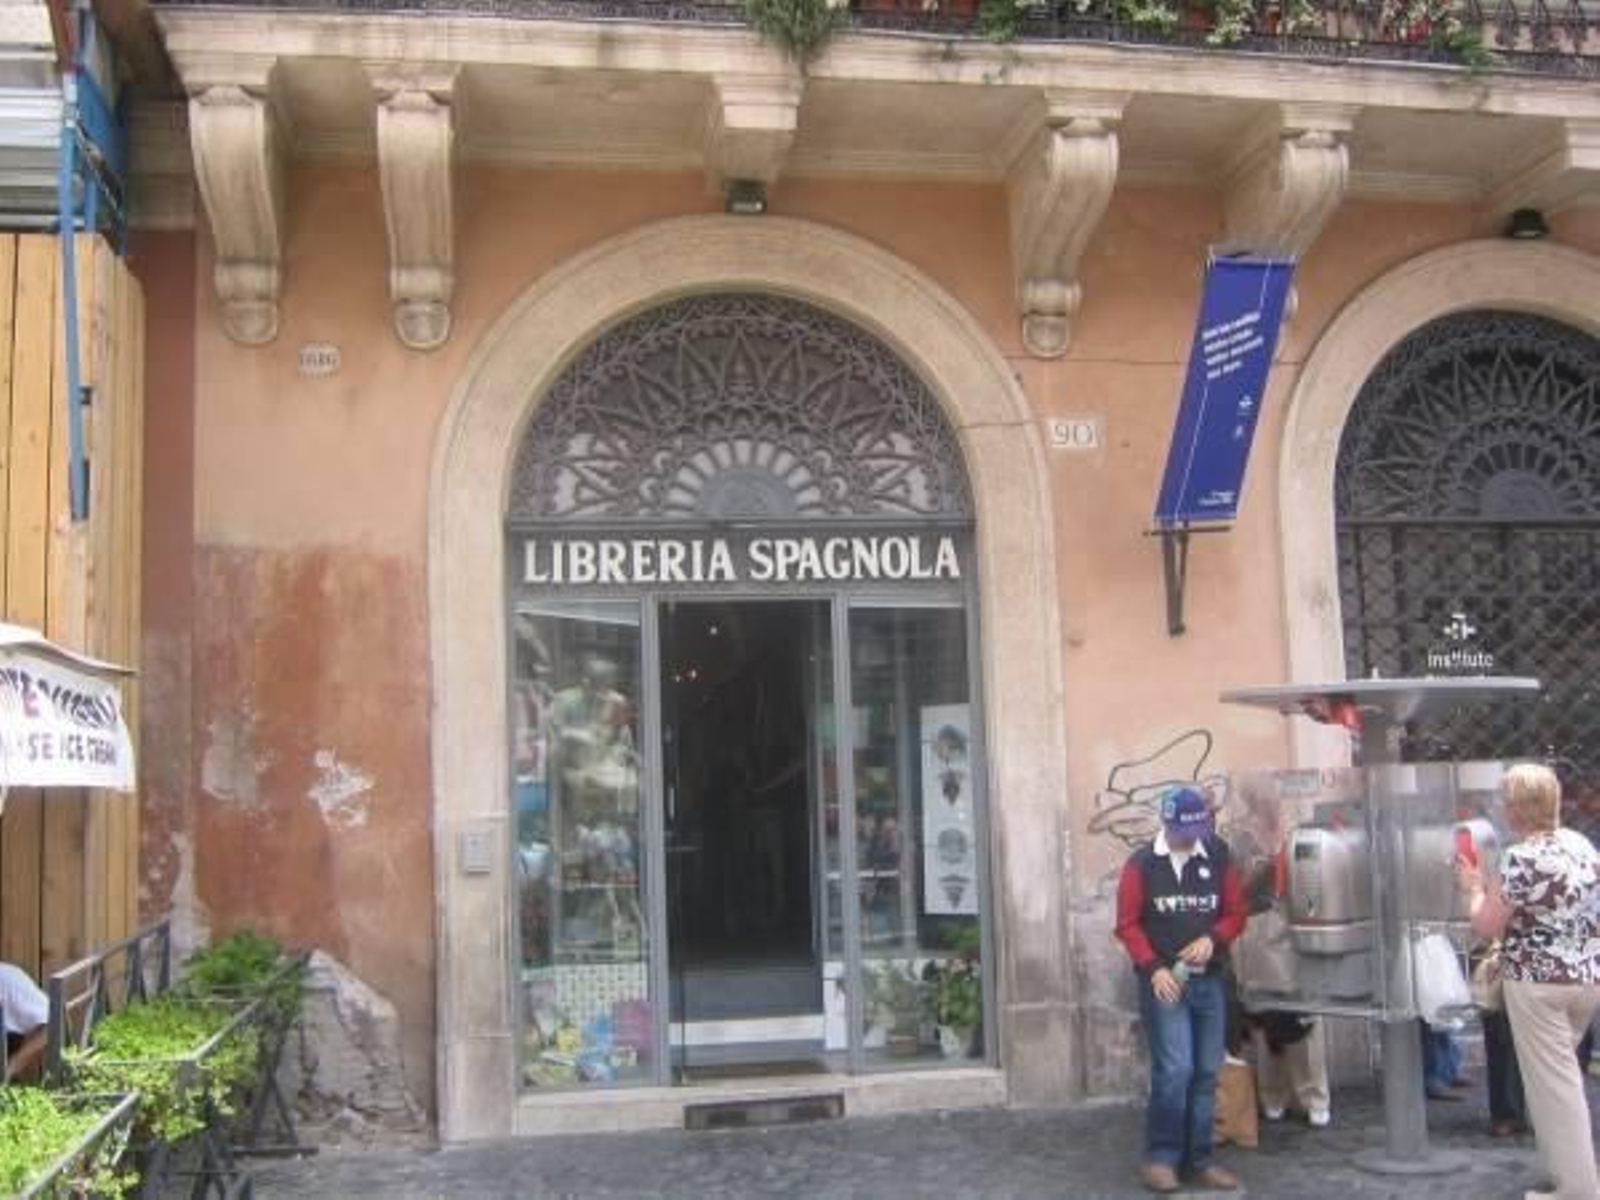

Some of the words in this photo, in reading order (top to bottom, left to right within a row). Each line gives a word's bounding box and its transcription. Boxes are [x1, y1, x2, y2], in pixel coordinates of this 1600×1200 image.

[1053, 423, 1094, 446] 90
[523, 539, 738, 584] LIBRERIA
[748, 536, 961, 581] SPAGNOLA
